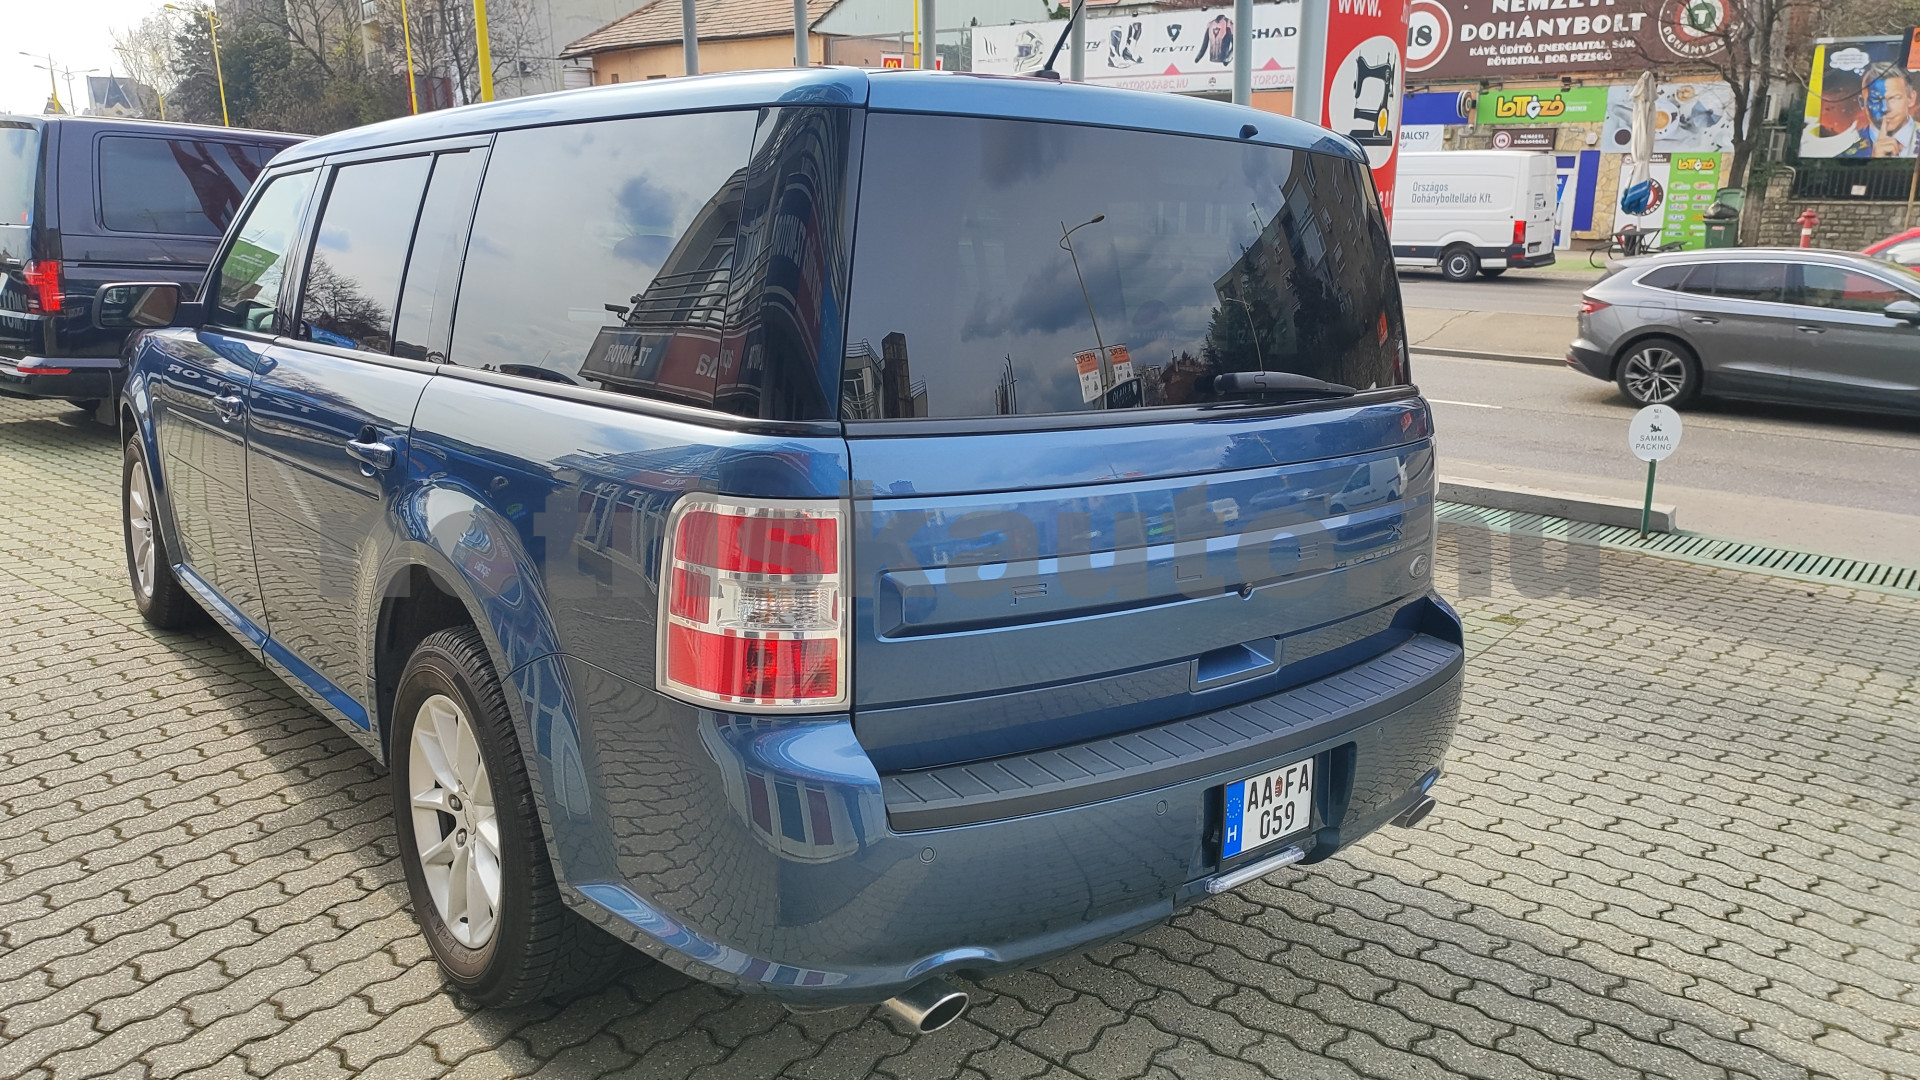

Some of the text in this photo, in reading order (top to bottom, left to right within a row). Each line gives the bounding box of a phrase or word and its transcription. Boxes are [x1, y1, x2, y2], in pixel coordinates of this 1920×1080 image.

[1460, 13, 1647, 42] DOHÁNYBOLT
[1412, 181, 1449, 193] Országos
[1247, 764, 1309, 812] AA FA
[1227, 825, 1238, 843] H
[1260, 801, 1295, 839] 059
